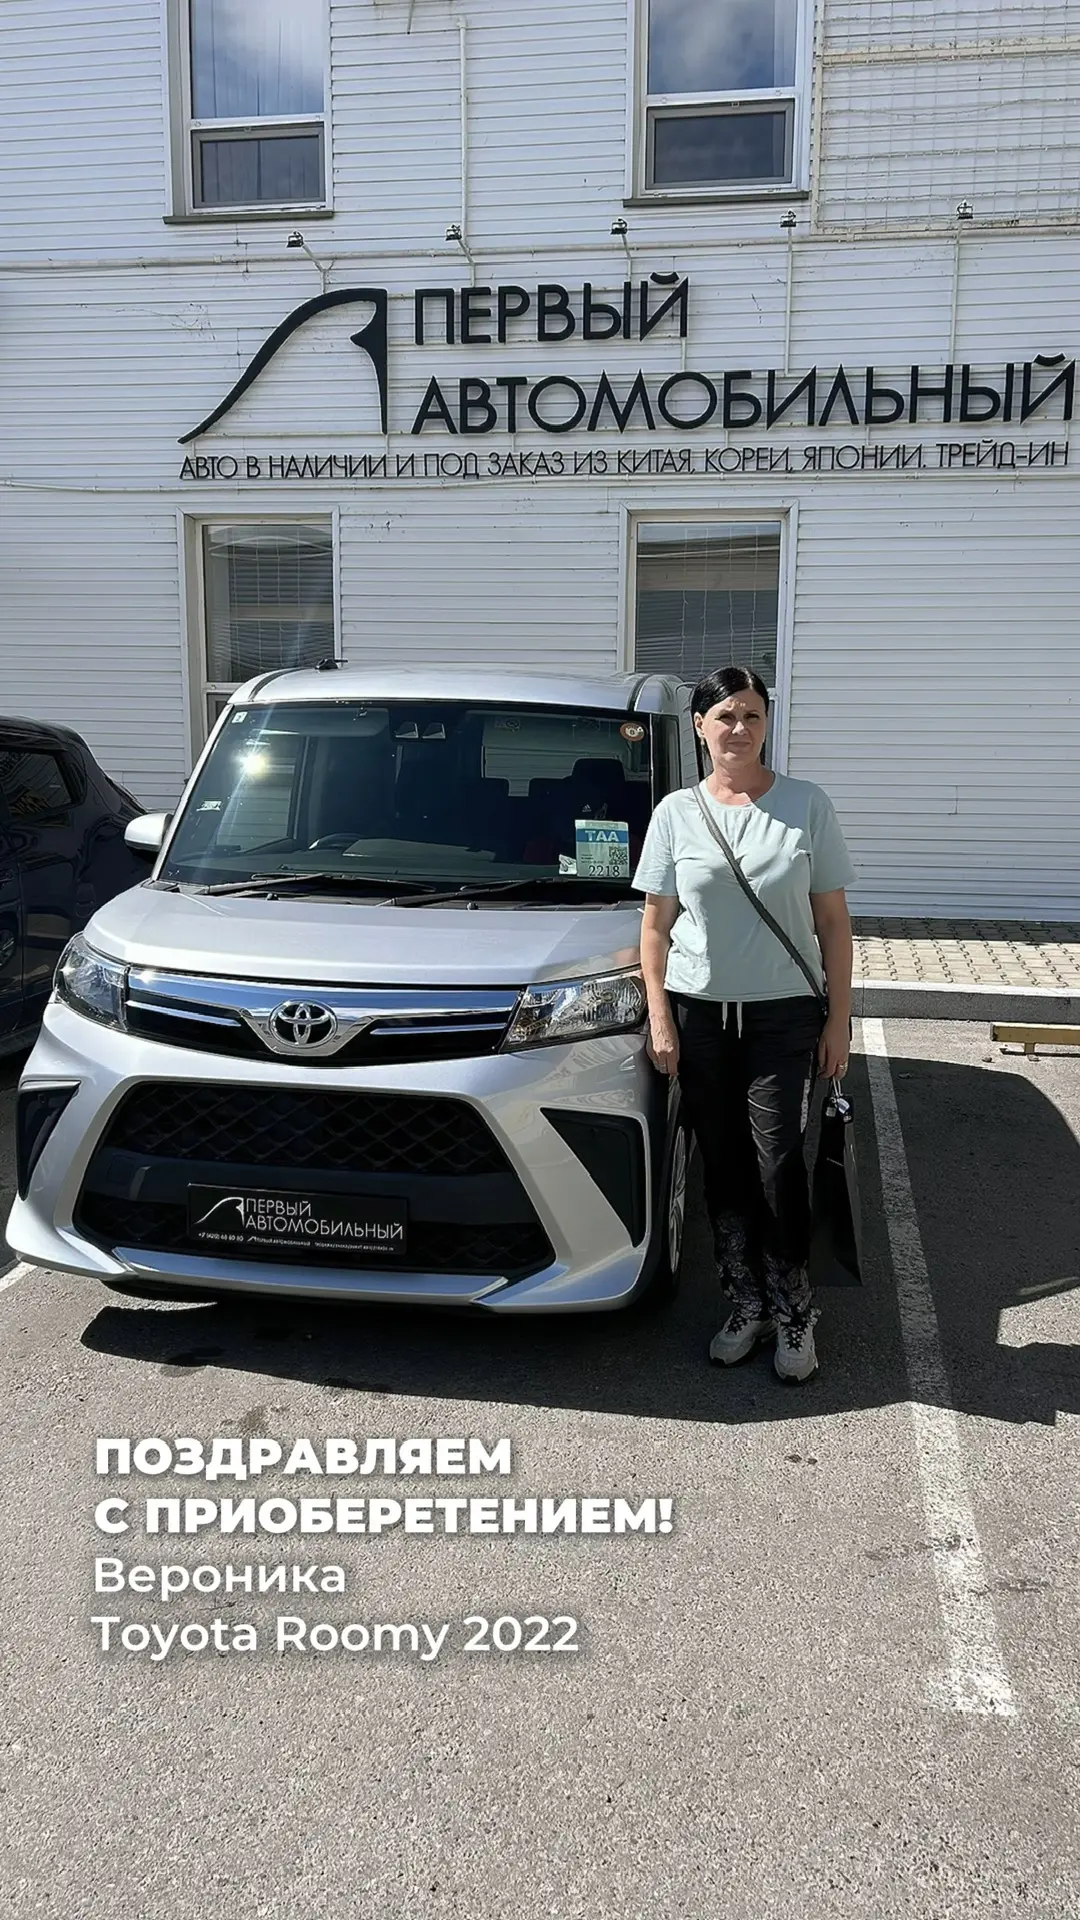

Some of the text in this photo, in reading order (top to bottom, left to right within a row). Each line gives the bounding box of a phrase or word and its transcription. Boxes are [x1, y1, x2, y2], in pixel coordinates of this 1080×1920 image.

[415, 272, 688, 345] ПЕРВЫЙ
[411, 353, 1075, 435] АВТОМОБИЛЬНЫЙ
[179, 455, 238, 479] АВТО
[247, 455, 261, 478] В
[269, 453, 387, 478] НАЛИЧИИ
[397, 452, 415, 478] И
[424, 452, 479, 479] ПОД
[488, 451, 565, 476] ЗАКАЗ
[573, 450, 608, 475] ИЗ
[617, 448, 696, 474] КИТАЯ,
[802, 444, 927, 470] ЯПОНИИ.
[936, 439, 1069, 469] ТРЕЙД-ИН
[584, 830, 620, 842] TAA
[588, 865, 621, 878] 2218
[246, 1198, 312, 1217] ПЕРВЫЙ
[245, 1214, 404, 1240] АВТОМОБИЛЬНЫЙ
